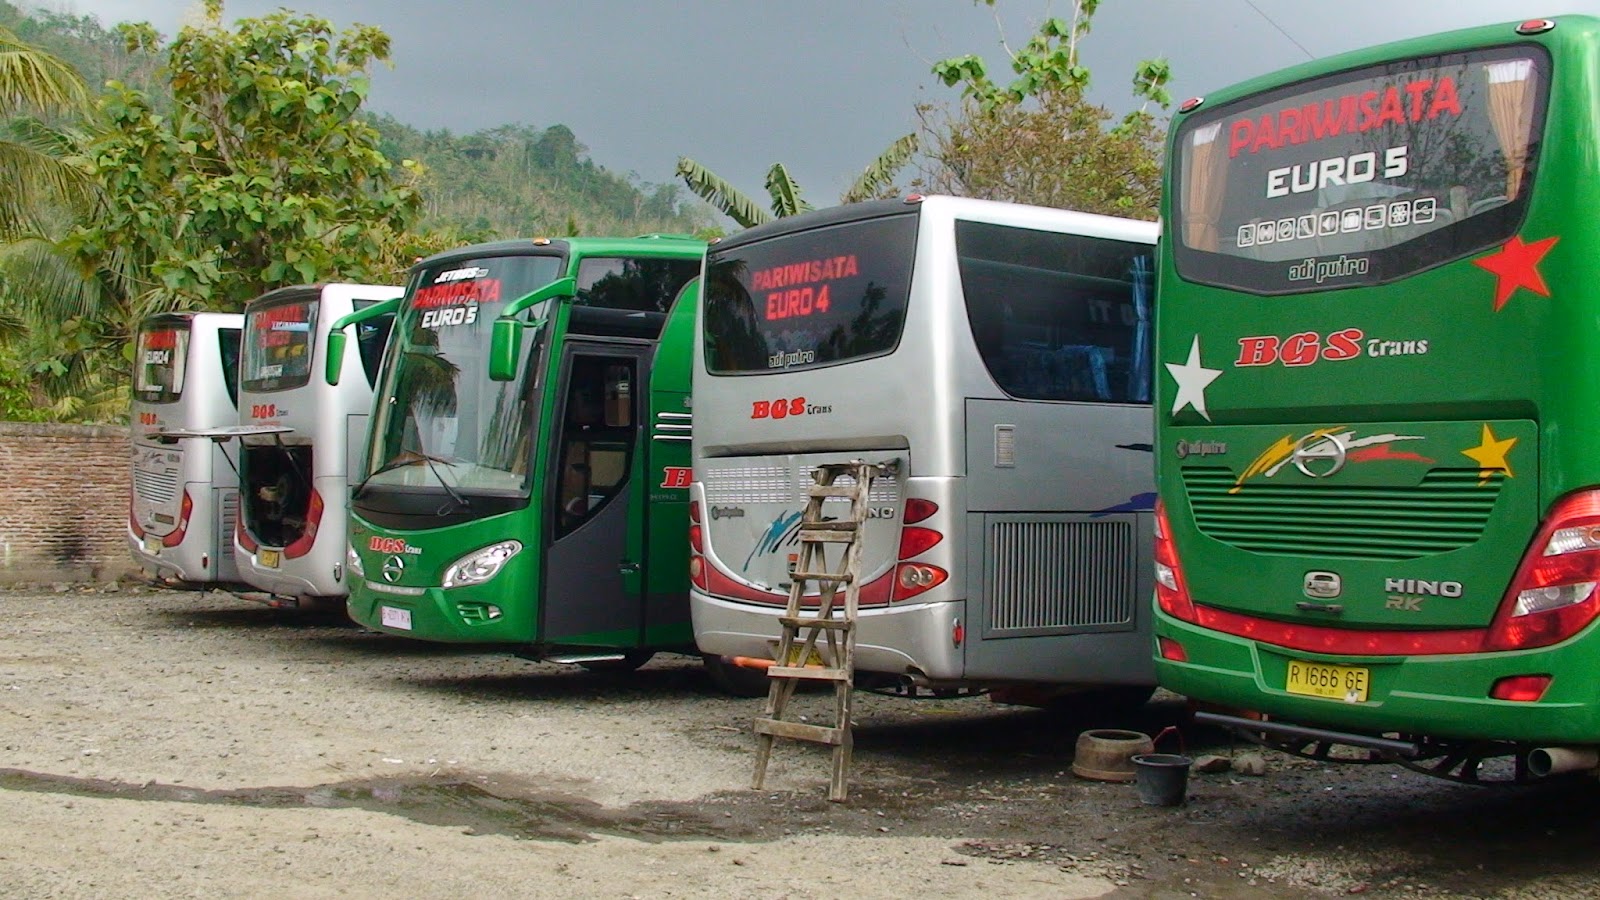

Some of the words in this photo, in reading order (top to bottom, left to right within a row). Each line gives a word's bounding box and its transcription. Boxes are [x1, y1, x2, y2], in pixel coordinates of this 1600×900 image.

[1228, 77, 1461, 158] PARIWISATA
[1266, 151, 1376, 198] EURO
[1385, 145, 1408, 178] 5
[751, 255, 858, 291] PARIWISATA
[412, 278, 503, 310] PARIWISATA
[765, 287, 813, 320] EURO
[816, 284, 831, 313] 4
[421, 307, 466, 328] EURO
[465, 306, 478, 325] 5
[1234, 328, 1363, 367] BGS
[751, 397, 806, 419] BGS
[868, 506, 894, 519] NO
[370, 535, 405, 553] BGS
[1385, 578, 1463, 598] HINO
[1385, 595, 1425, 612] RK
[1291, 665, 1300, 684] R
[1305, 667, 1339, 688] 1666
[1345, 671, 1364, 691] GE
